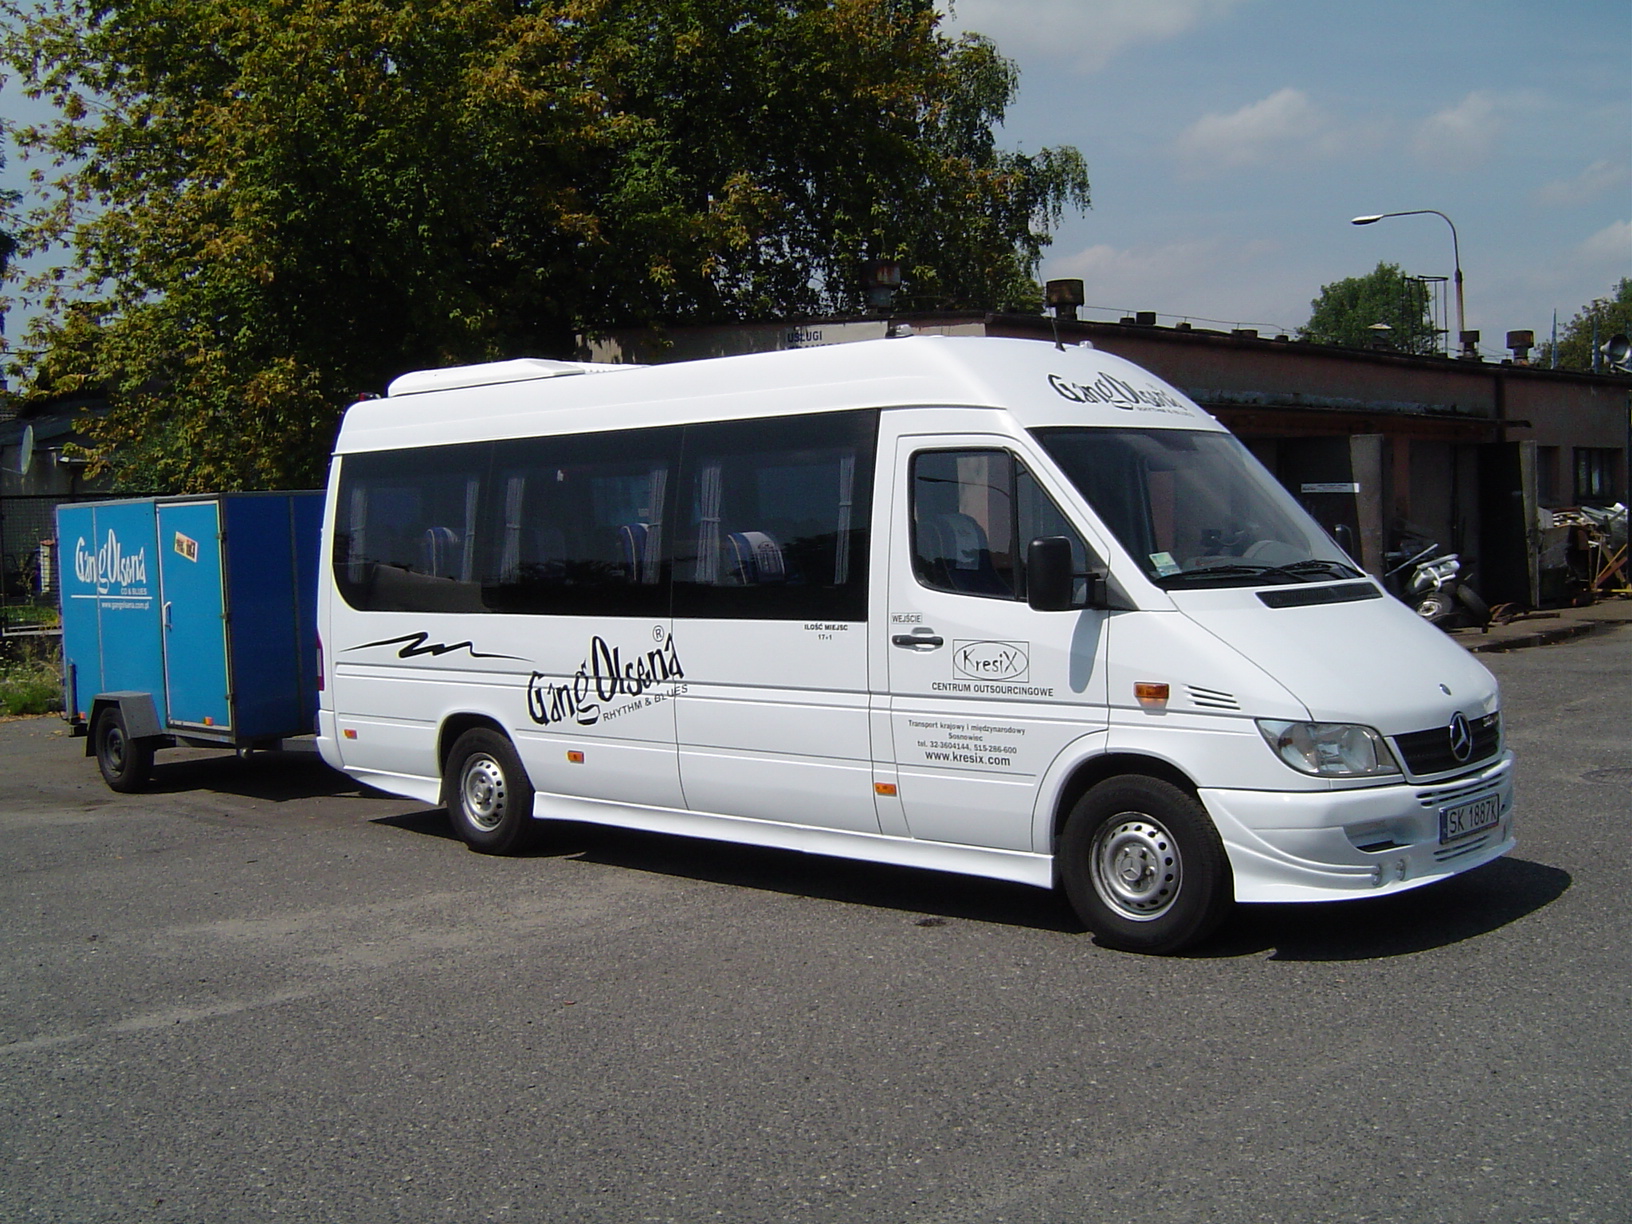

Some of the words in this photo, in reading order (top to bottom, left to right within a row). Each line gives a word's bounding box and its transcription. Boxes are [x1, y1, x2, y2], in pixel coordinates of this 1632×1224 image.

[891, 613, 921, 623] WEJŚCIE
[824, 623, 849, 632] MIEJSC
[962, 648, 1018, 674] KresiX
[931, 682, 971, 692] CENTRUM
[973, 684, 1054, 697] OUTSOURCINGOWE
[602, 700, 643, 722] RHYTHM
[644, 696, 652, 707] &
[653, 683, 688, 704] BLUES
[908, 719, 938, 730] Transport
[940, 722, 965, 732] krajowy
[948, 732, 983, 742] Sosnowiec
[925, 751, 1011, 766] www.kresix.com
[1449, 808, 1465, 833] SK
[1468, 799, 1497, 827] 1887K
